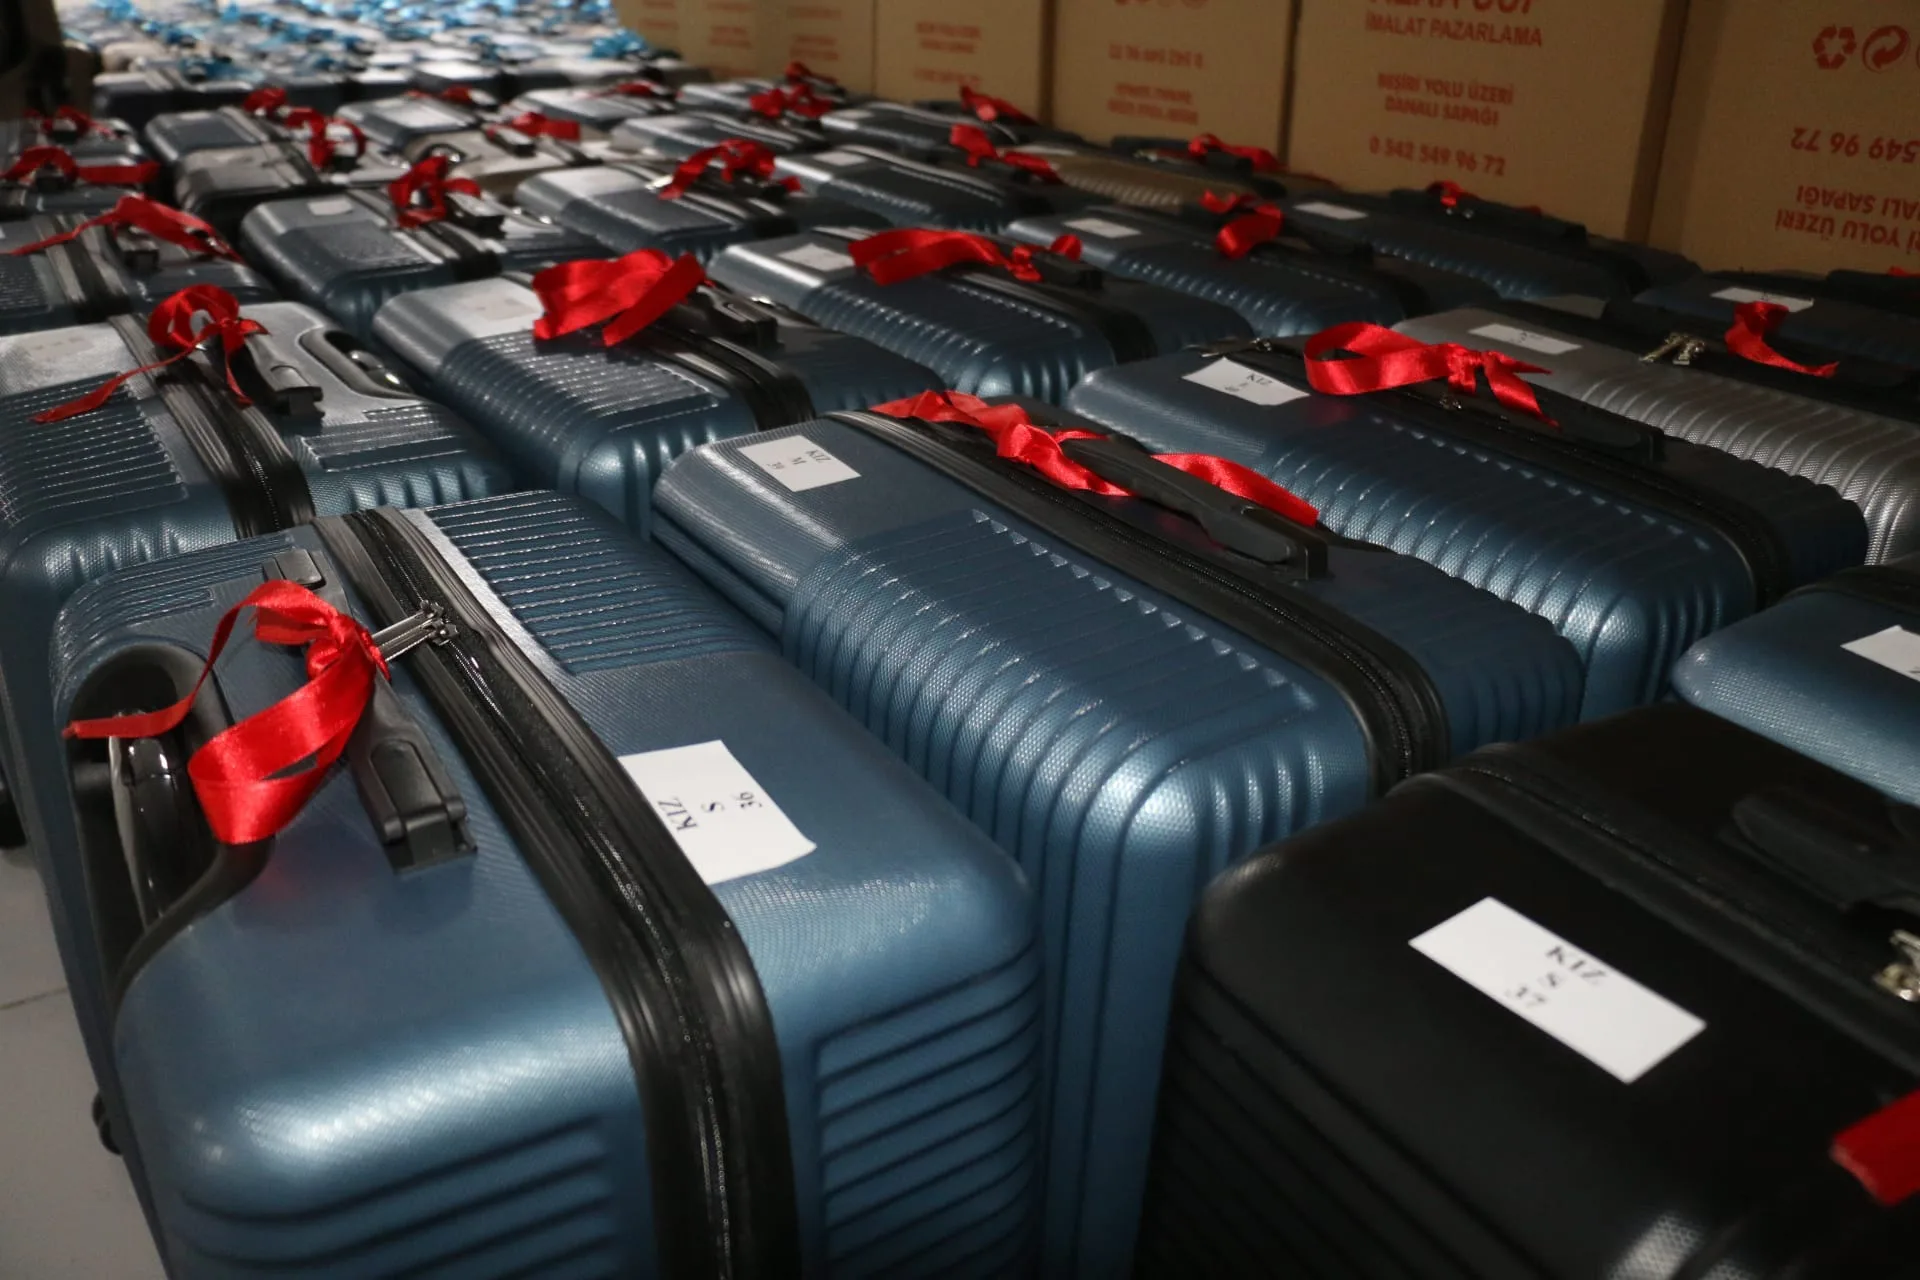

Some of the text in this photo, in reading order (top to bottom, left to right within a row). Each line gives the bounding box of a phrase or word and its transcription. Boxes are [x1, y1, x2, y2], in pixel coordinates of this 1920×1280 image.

[1429, 17, 1543, 47] PAZARLAMA
[1424, 78, 1464, 99] YOLU
[1789, 126, 1822, 153] 72
[1829, 131, 1861, 158] 96
[1368, 134, 1380, 155] 0
[1418, 142, 1451, 166] 549
[1455, 149, 1478, 173] 96
[1482, 153, 1507, 177] 72
[1795, 184, 1877, 214] SAPAĞI
[1841, 219, 1900, 248] YOLU
[804, 449, 832, 463] KIZ
[656, 796, 698, 832] KIZ
[700, 801, 725, 816] S
[736, 790, 764, 811] 36
[1546, 945, 1607, 986] KIZ
